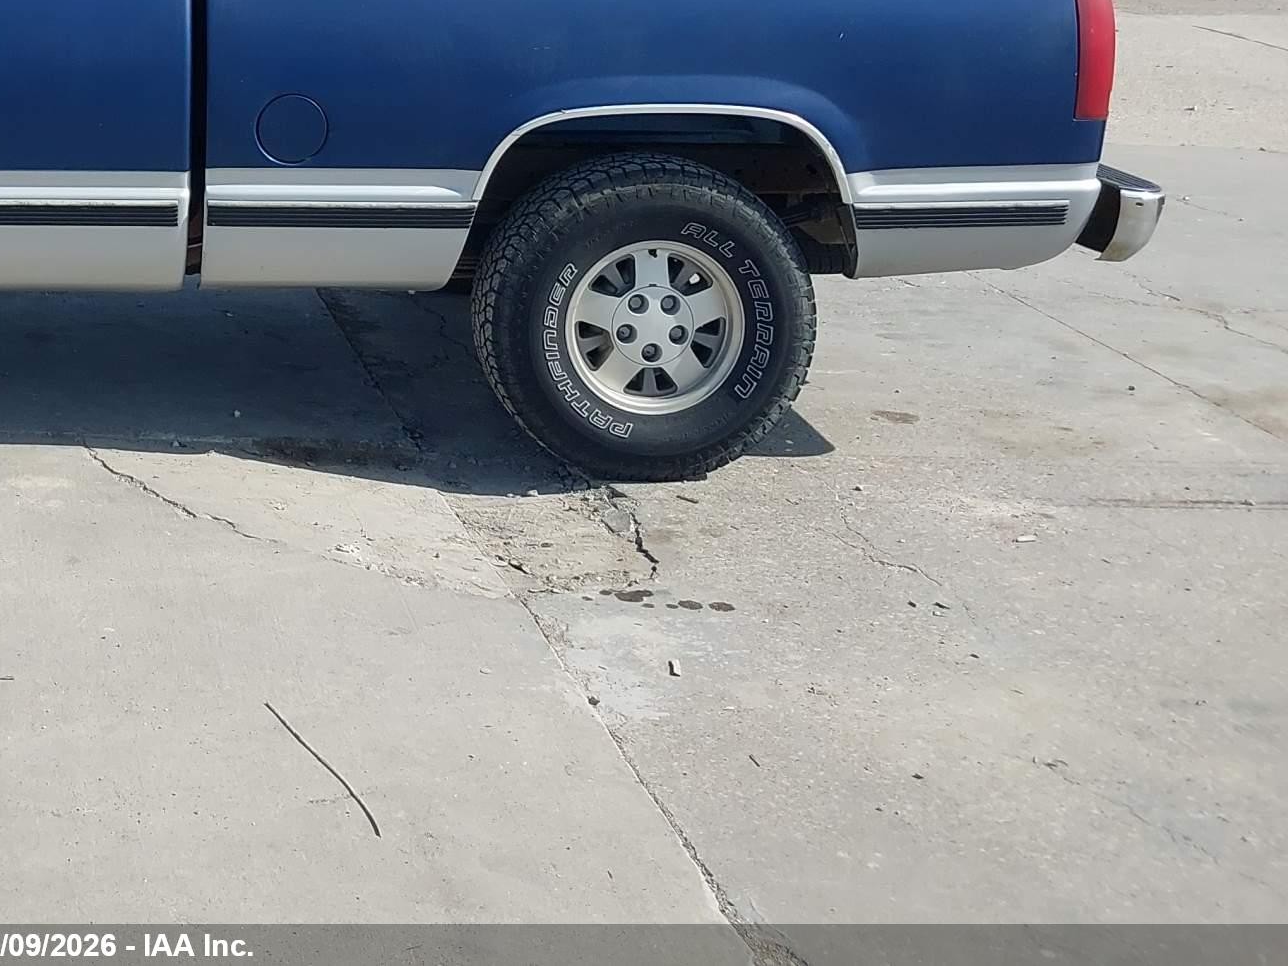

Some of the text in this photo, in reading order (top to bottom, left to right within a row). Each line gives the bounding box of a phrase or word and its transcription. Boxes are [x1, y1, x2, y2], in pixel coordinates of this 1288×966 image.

[542, 262, 634, 440] PATHFINDER
[680, 221, 775, 400] ALL TERRAIN
